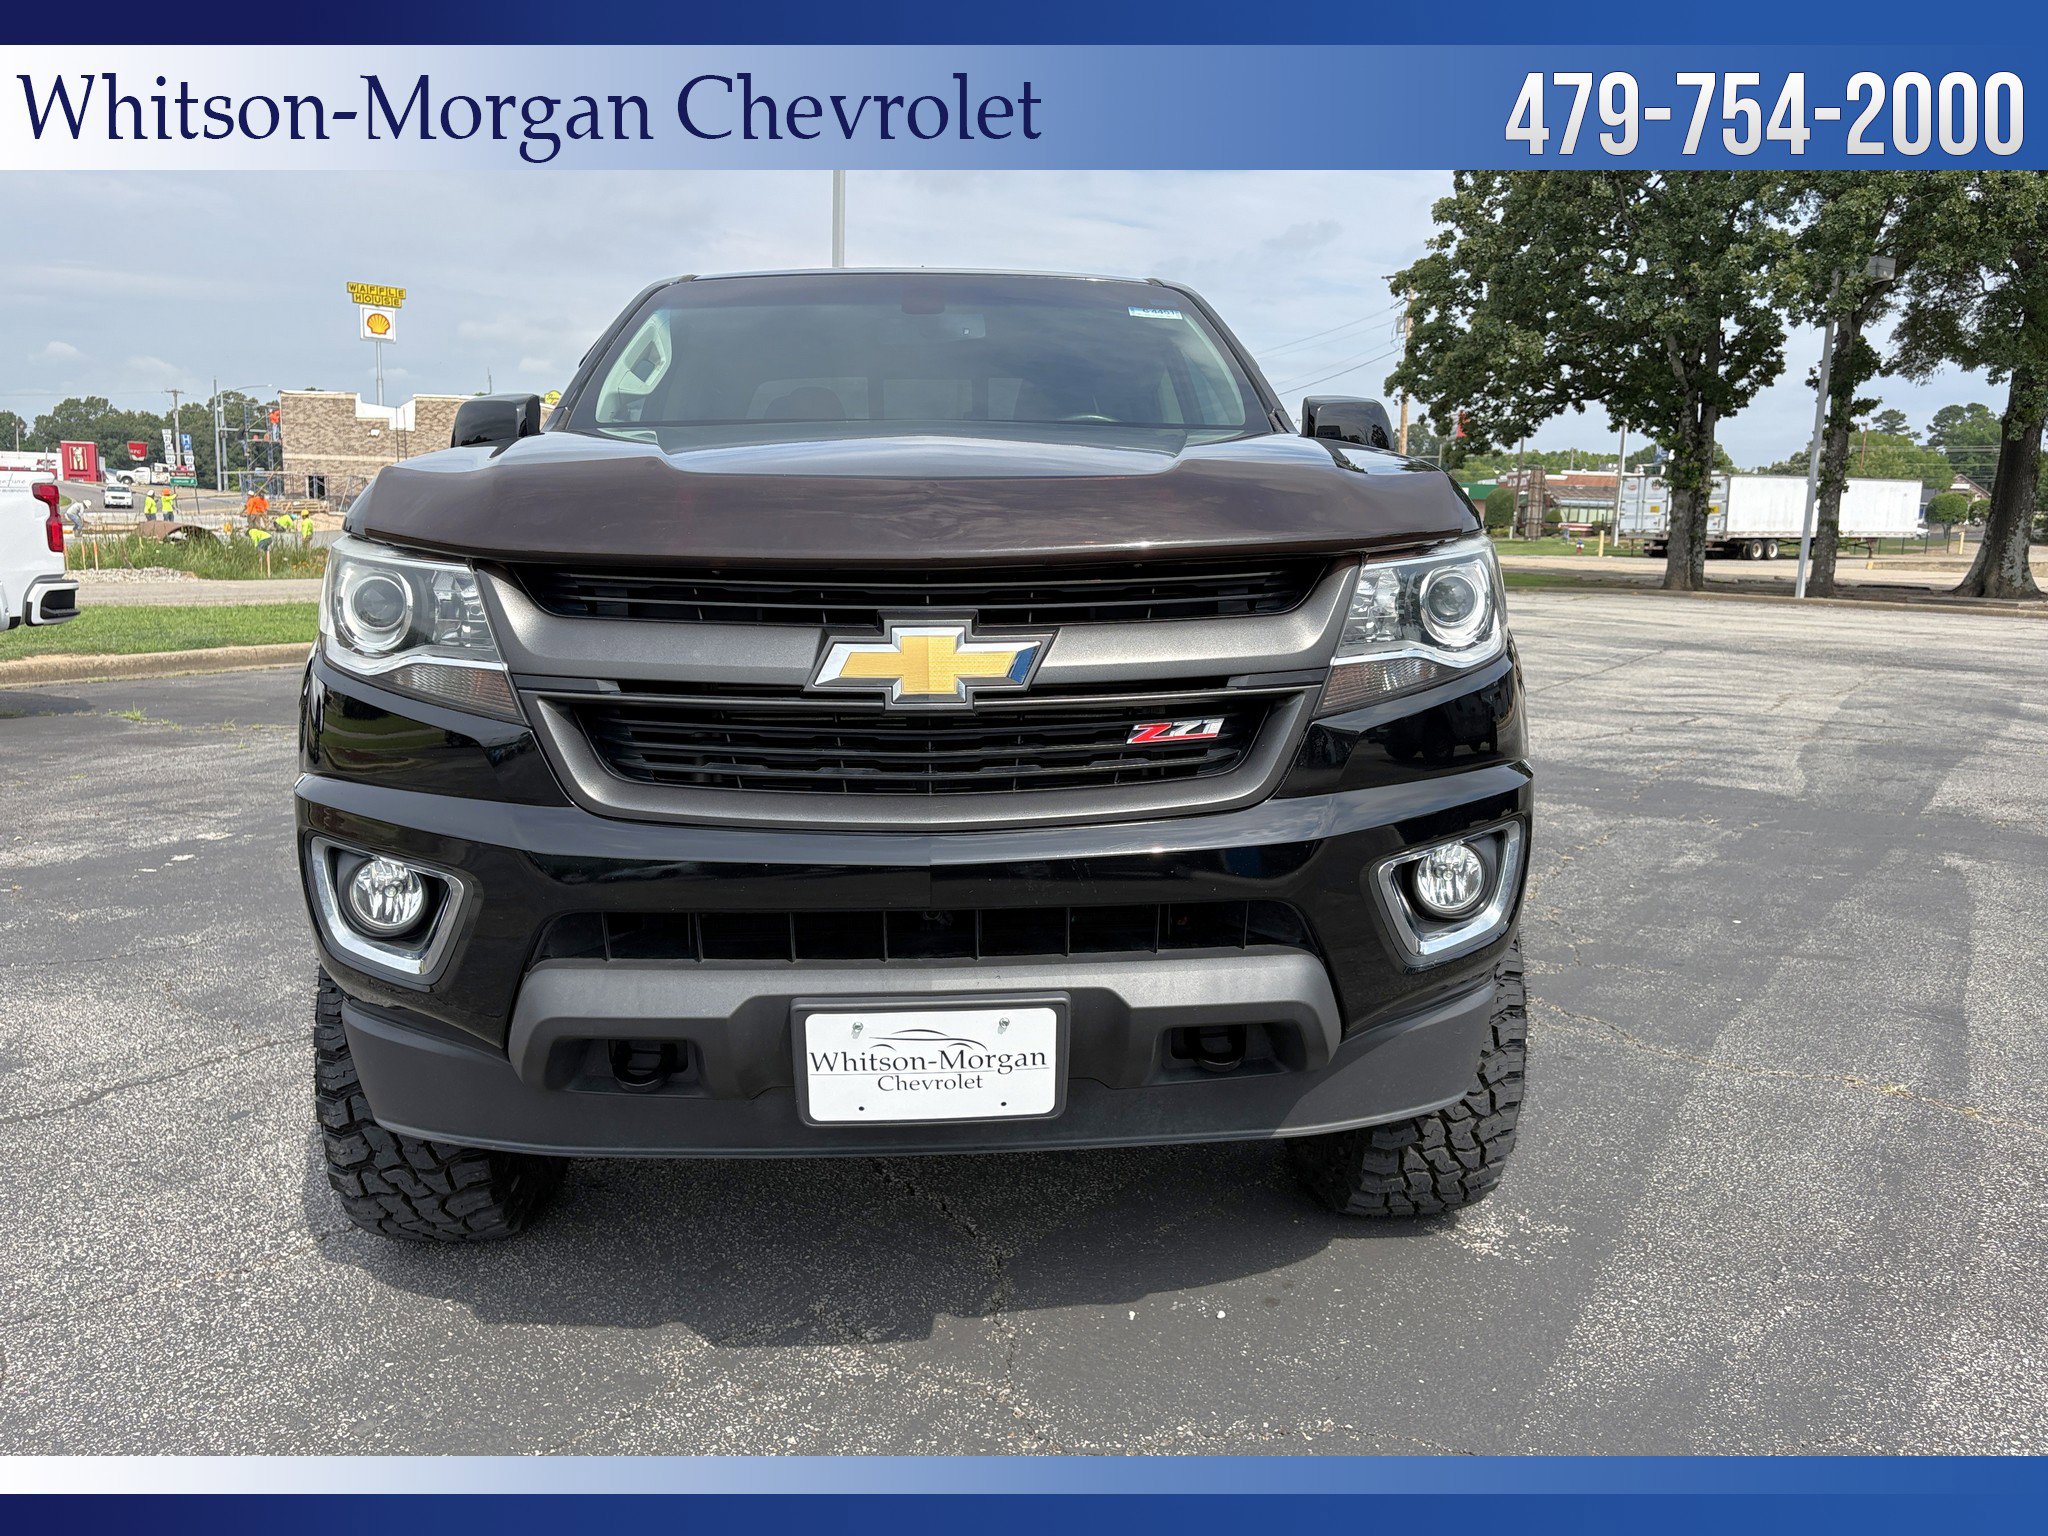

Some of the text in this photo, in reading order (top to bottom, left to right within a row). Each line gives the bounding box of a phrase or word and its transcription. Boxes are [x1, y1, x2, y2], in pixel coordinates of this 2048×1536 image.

[348, 283, 405, 298] WAFFLE
[354, 293, 401, 306] HOUSE
[1126, 718, 1225, 744] Z71
[809, 1050, 1048, 1075] Whitson-Morgan
[877, 1073, 984, 1092] Chevrolet
